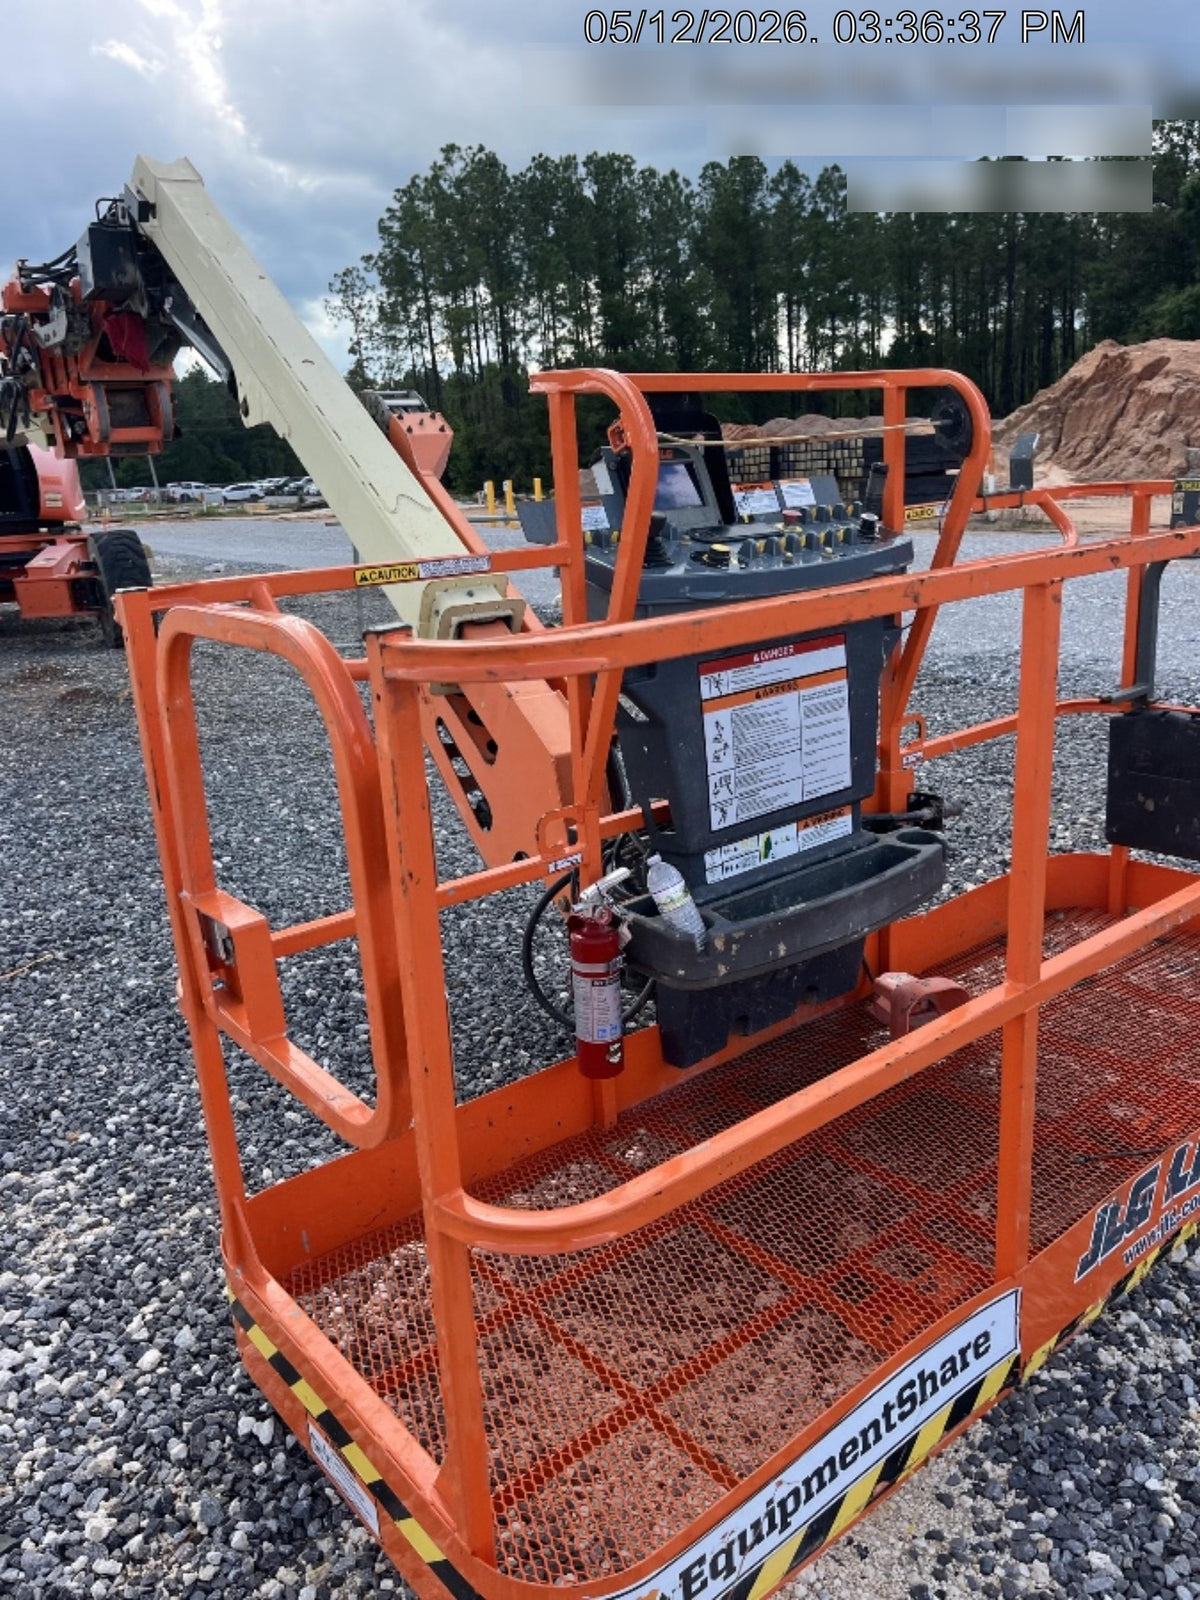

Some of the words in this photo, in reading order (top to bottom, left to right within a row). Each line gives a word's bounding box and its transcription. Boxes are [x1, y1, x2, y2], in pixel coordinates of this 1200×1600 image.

[369, 566, 416, 582] CAUTION
[1074, 1159, 1163, 1284] JLG
[679, 1330, 991, 1600] EquipmentShare
